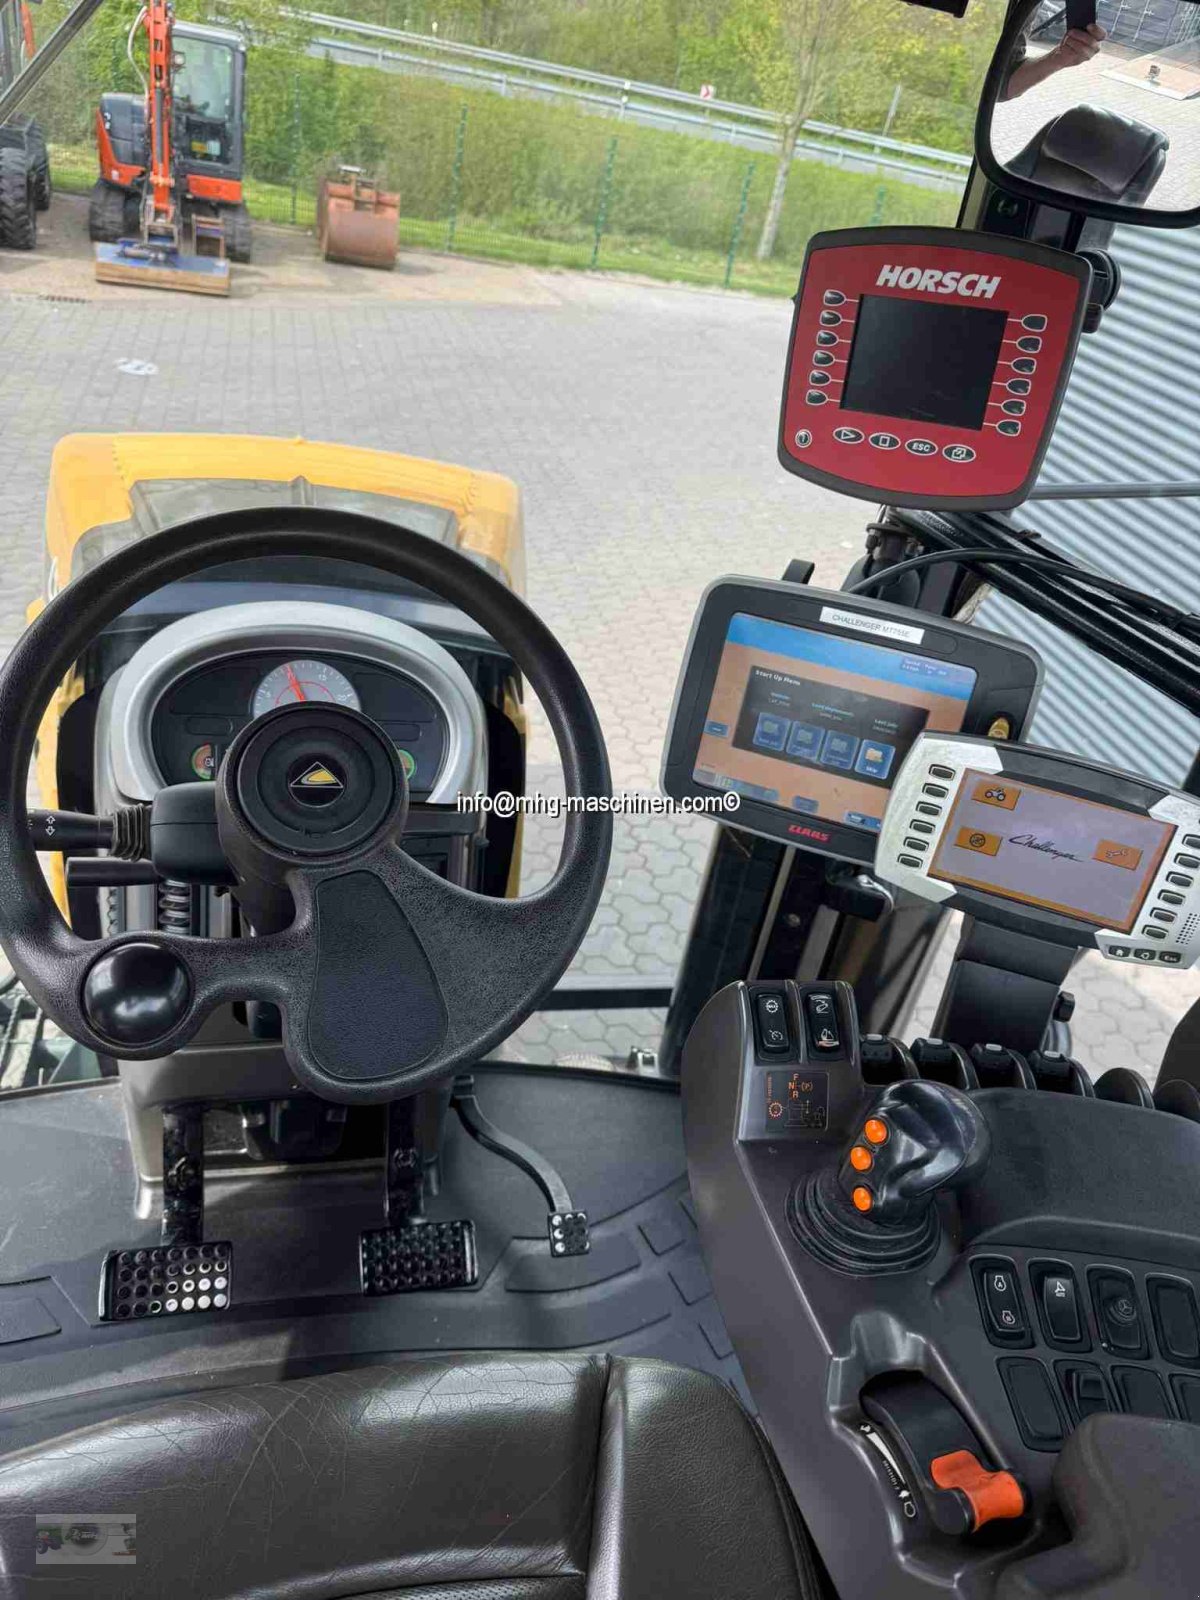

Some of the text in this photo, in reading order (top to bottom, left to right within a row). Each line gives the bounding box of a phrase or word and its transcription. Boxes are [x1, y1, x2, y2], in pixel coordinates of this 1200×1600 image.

[875, 264, 1002, 299] HORSCH
[911, 442, 931, 452] ESC
[788, 824, 830, 841] CLAAS
[1008, 834, 1084, 863] Challenger
